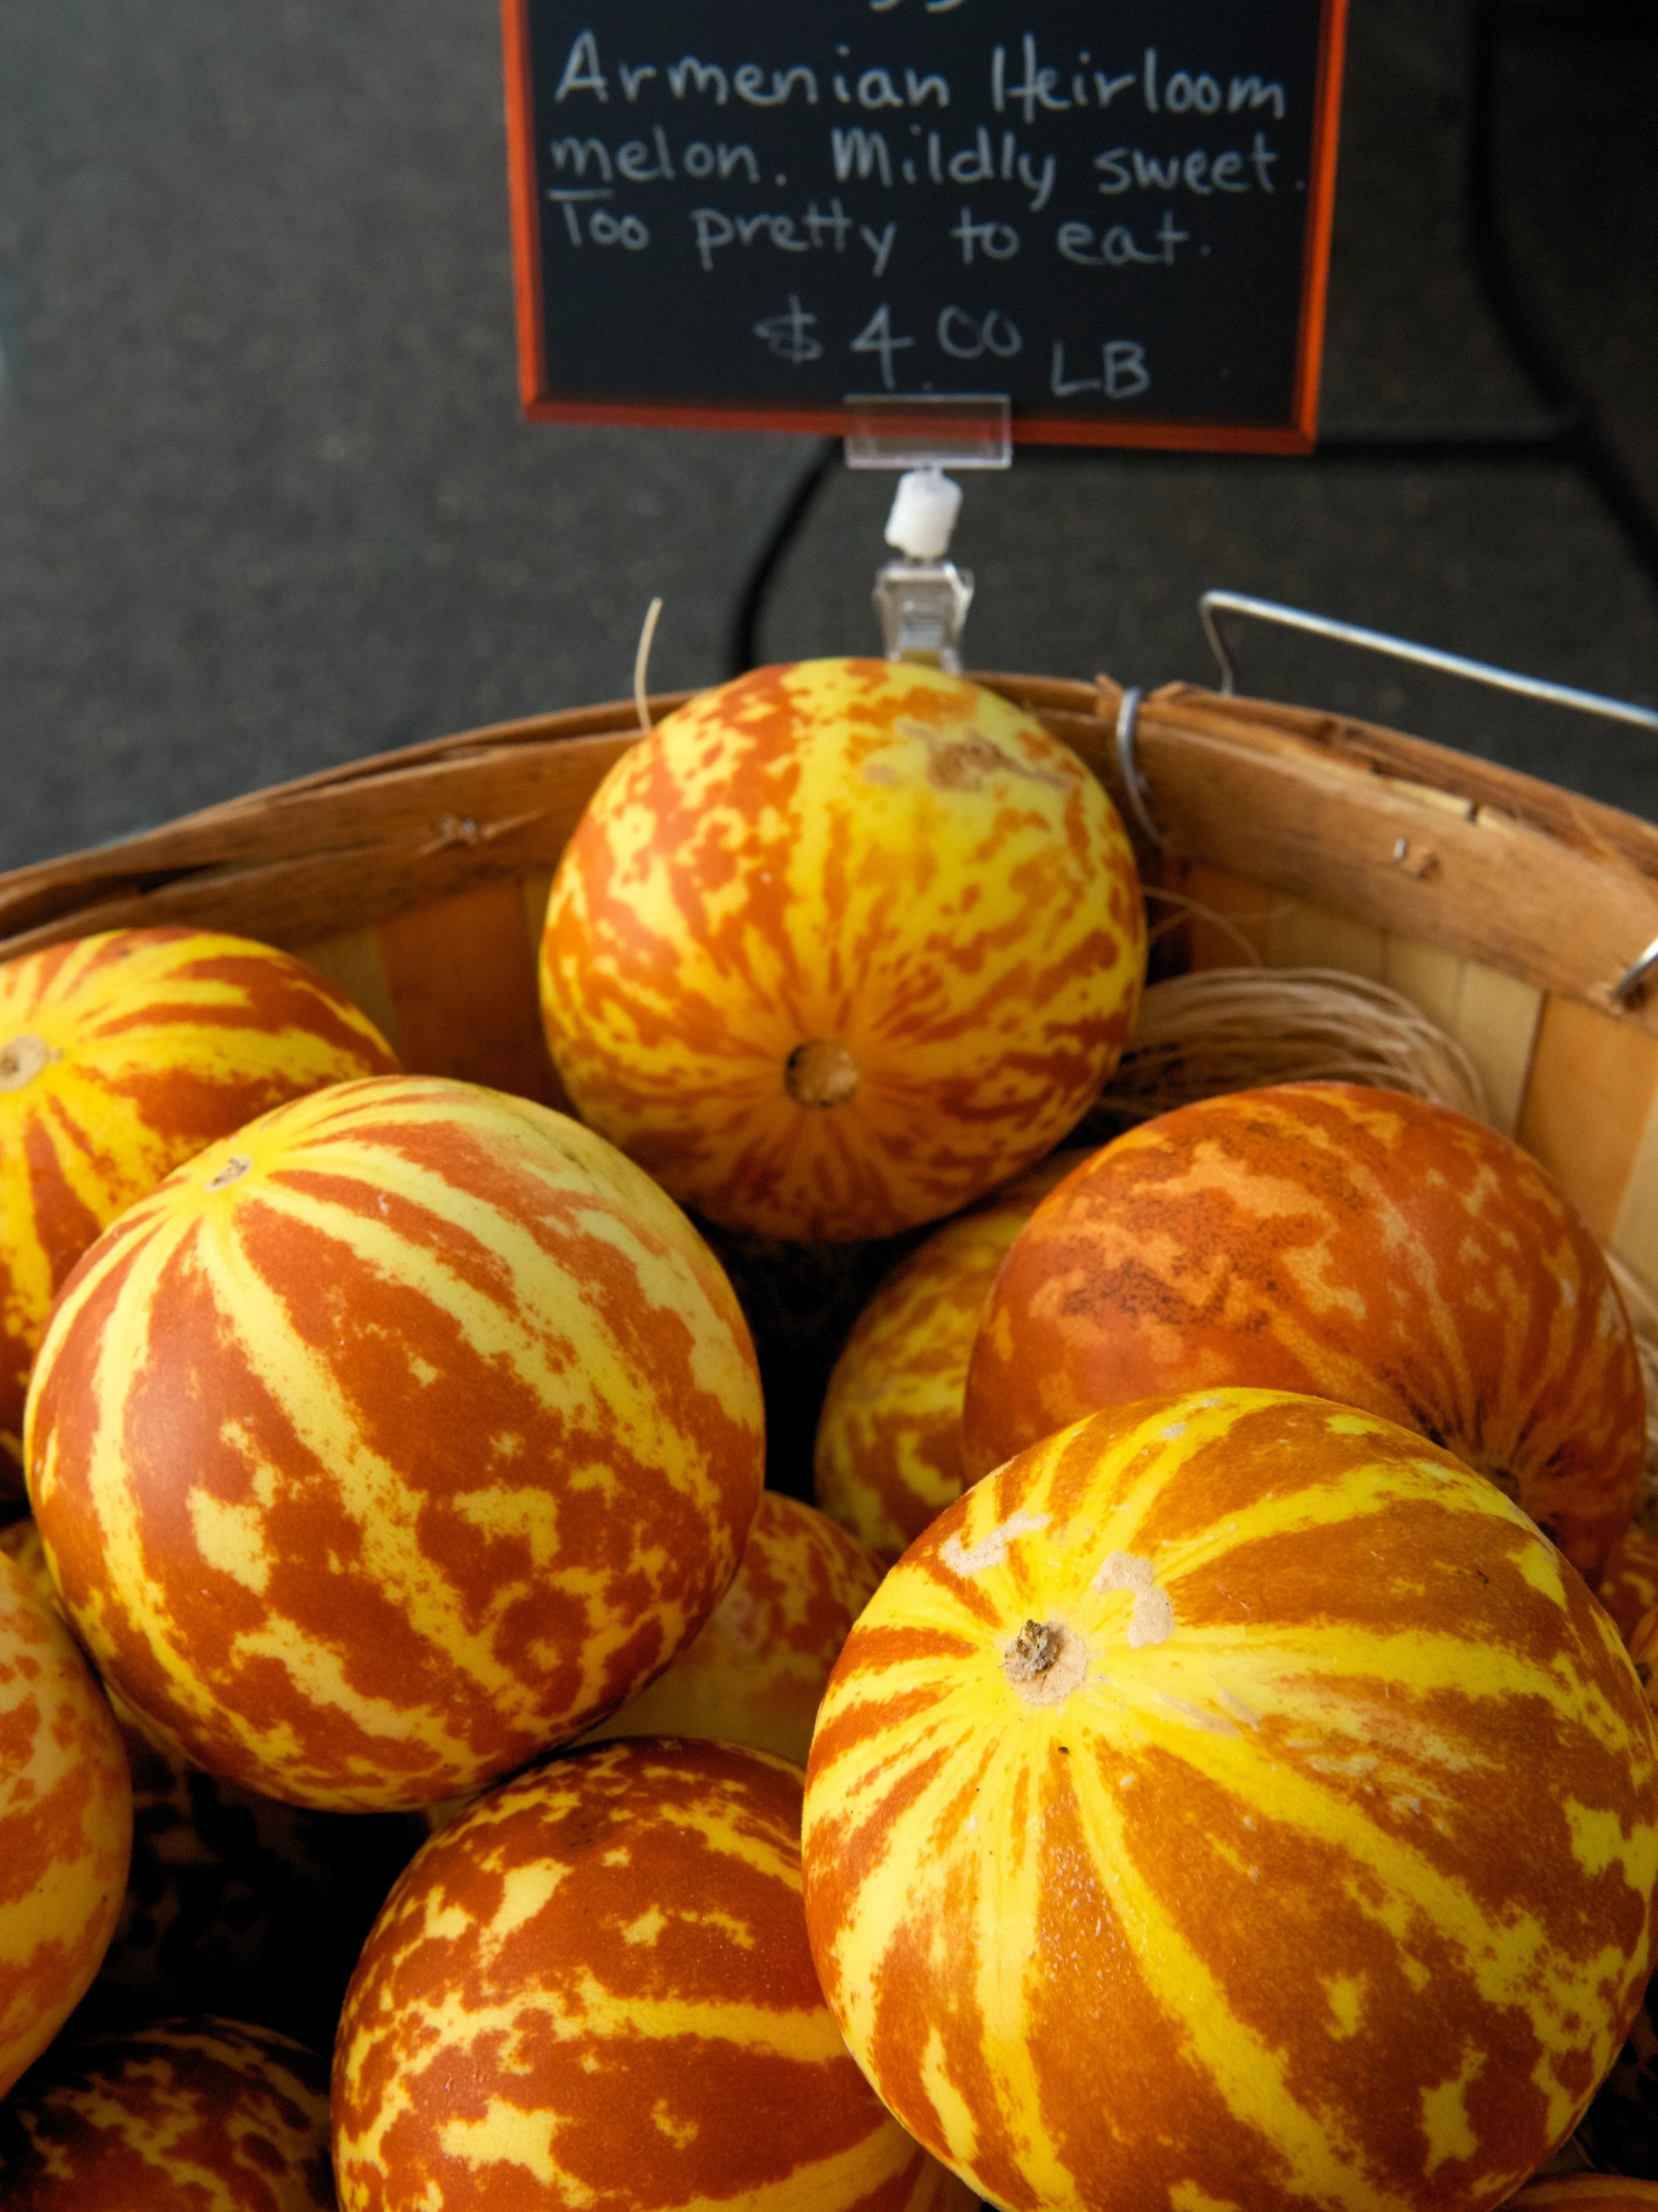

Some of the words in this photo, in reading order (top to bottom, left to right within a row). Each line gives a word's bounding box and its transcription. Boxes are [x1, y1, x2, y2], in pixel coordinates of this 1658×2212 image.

[554, 27, 950, 109] Armenian
[992, 32, 1287, 124] Heirloom
[550, 123, 787, 187] melon.
[832, 125, 1055, 212] Mildly
[1094, 130, 1306, 194] sweet.
[548, 188, 650, 250] Too
[690, 198, 897, 278] pretty
[950, 205, 1020, 265] to
[1057, 209, 1212, 266] eat.
[1049, 338, 1151, 399] LB
